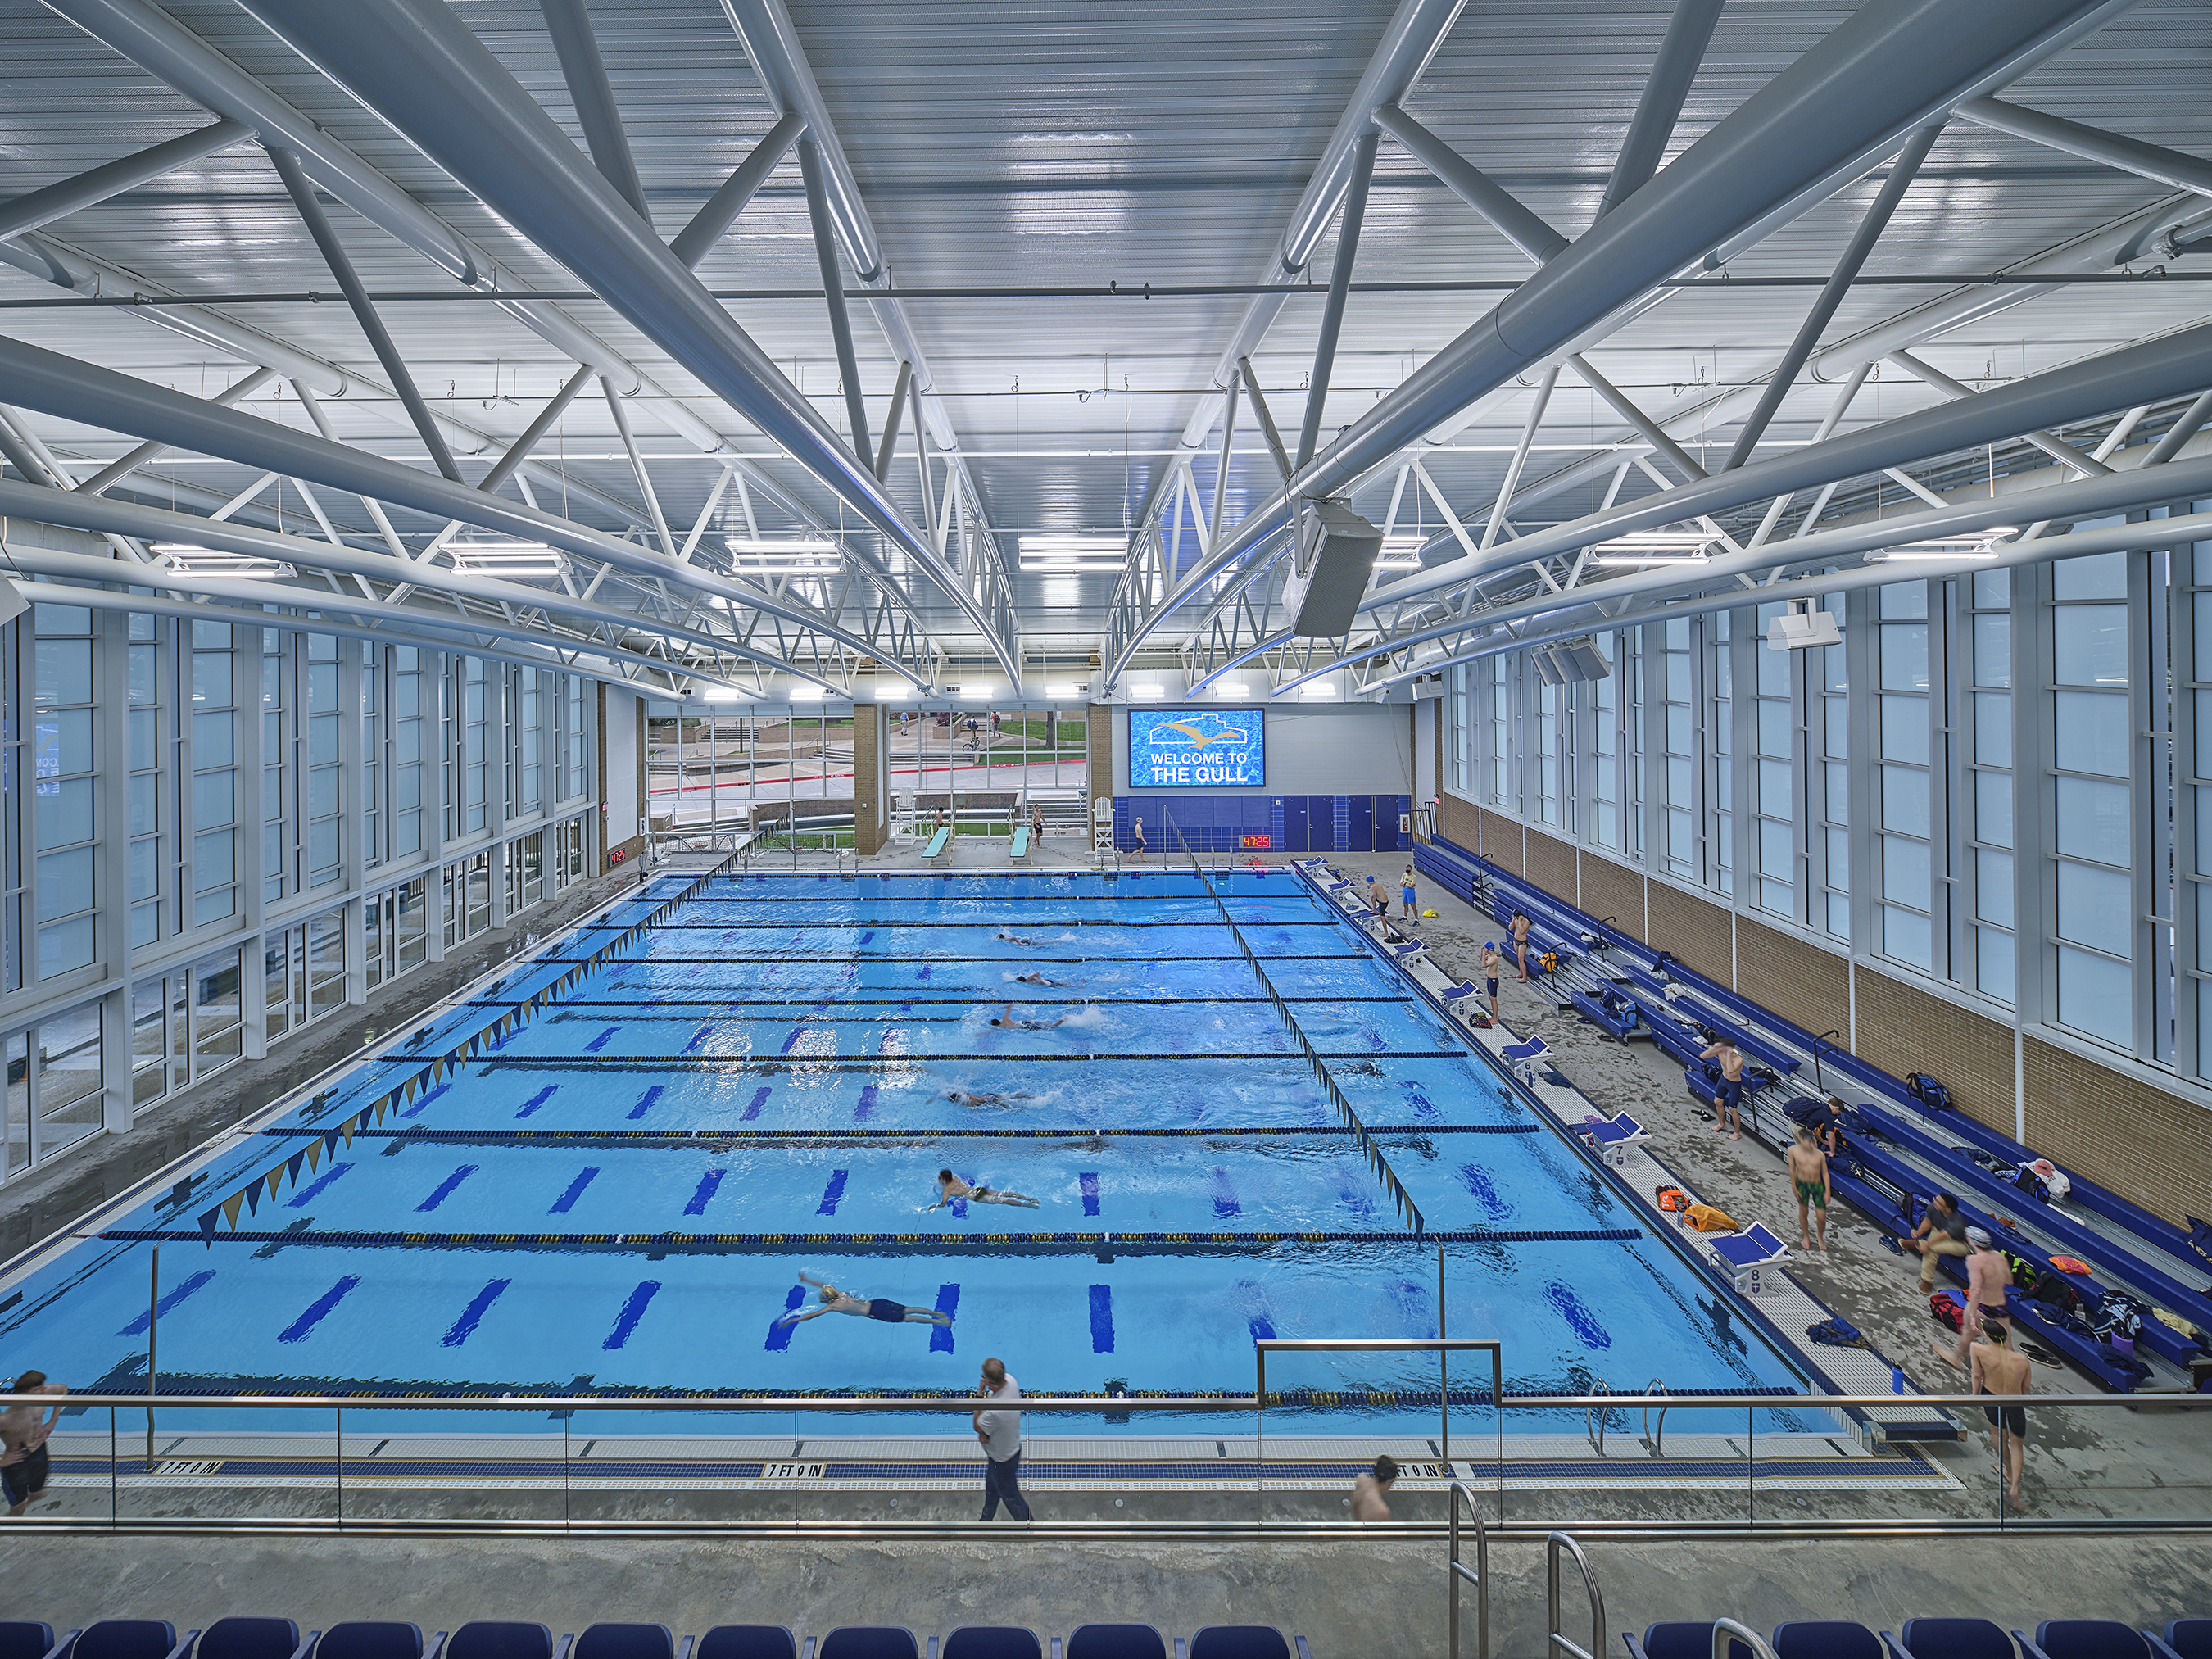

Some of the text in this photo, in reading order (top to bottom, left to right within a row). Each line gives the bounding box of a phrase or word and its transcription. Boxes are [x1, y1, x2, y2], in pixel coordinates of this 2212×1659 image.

[1150, 752, 1247, 764] WELCOME TO
[1150, 766, 1248, 782] THE GULL
[1243, 836, 1268, 847] 47:25
[1525, 1062, 1531, 1070] 6
[1616, 1145, 1624, 1155] 7
[1751, 1269, 1760, 1281] 8
[160, 1461, 176, 1474] 7
[170, 1461, 193, 1474] FT
[199, 1461, 220, 1474] IN
[768, 1464, 777, 1477] 7
[778, 1464, 795, 1477] FT
[808, 1464, 822, 1477] IN
[1422, 1464, 1439, 1477] IN
